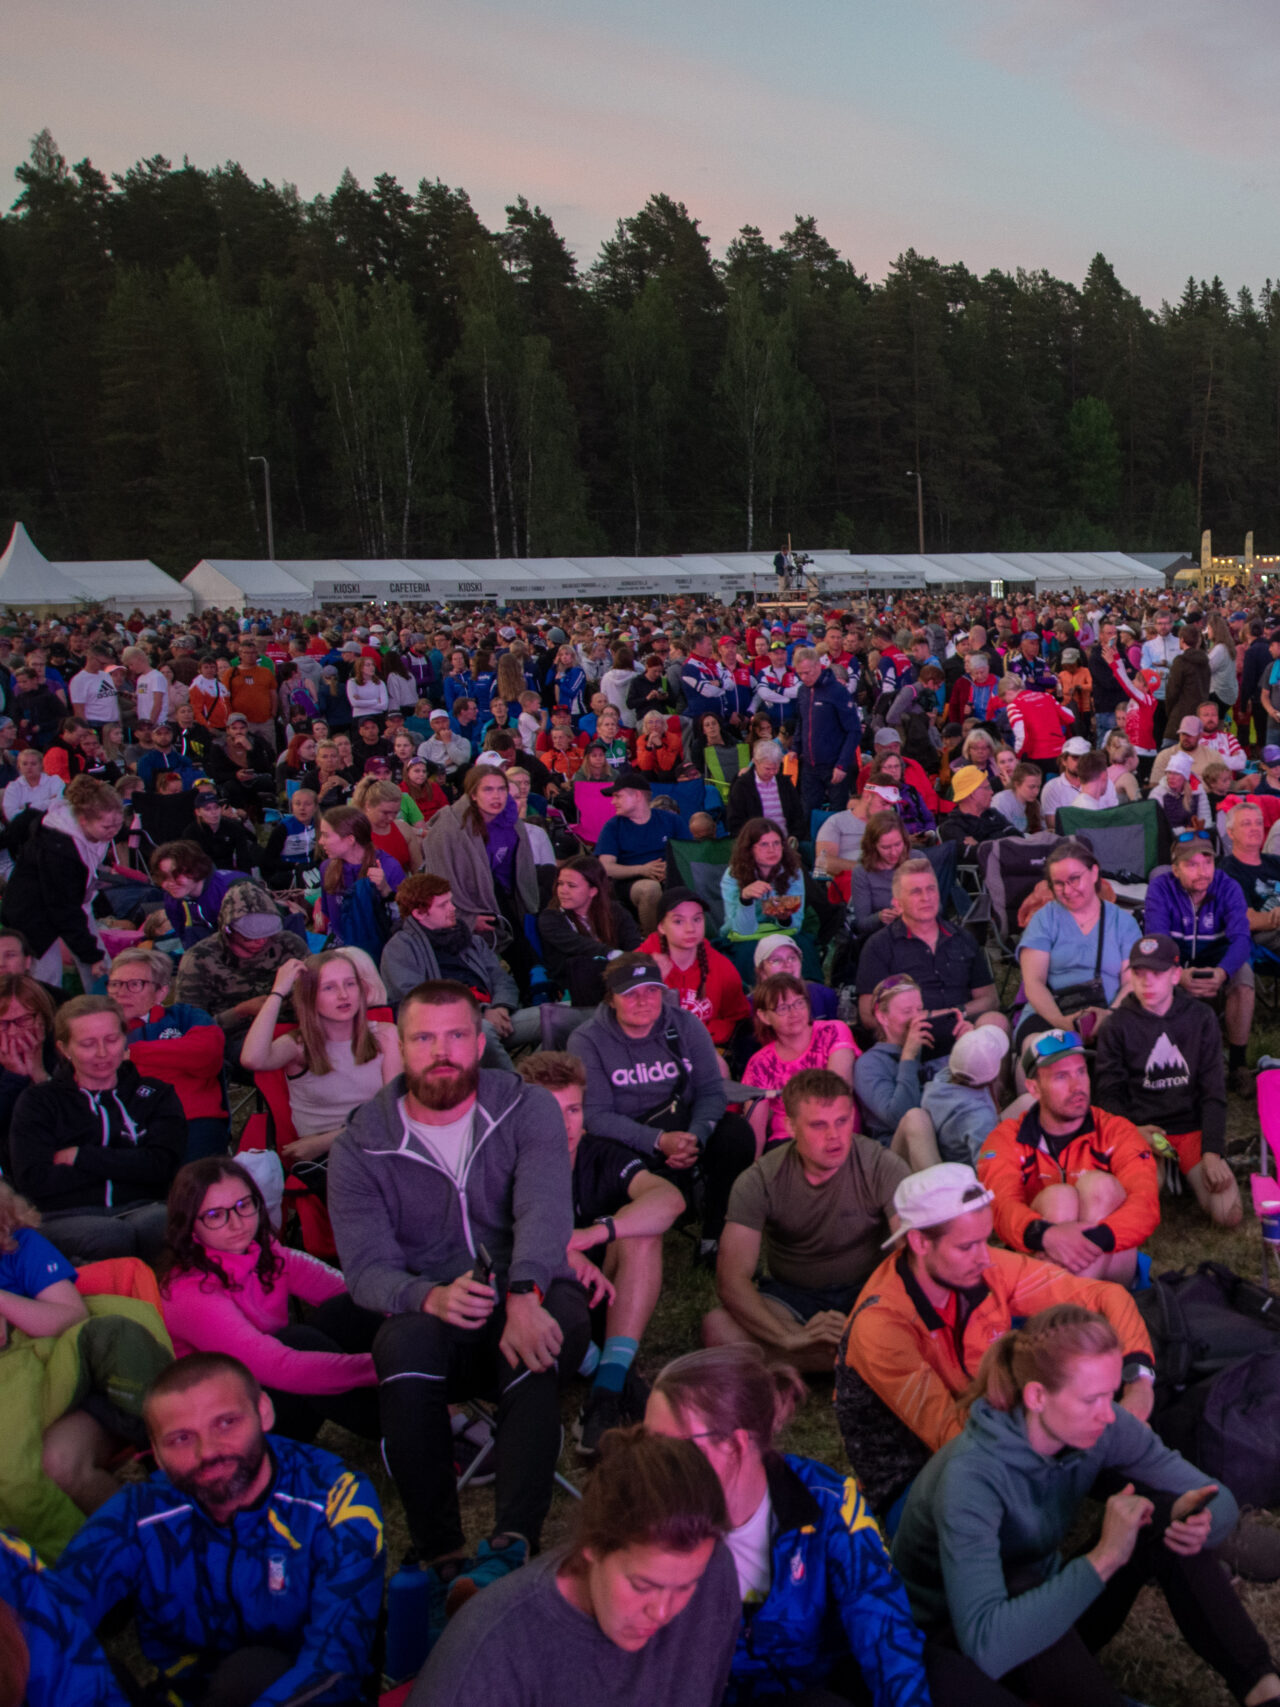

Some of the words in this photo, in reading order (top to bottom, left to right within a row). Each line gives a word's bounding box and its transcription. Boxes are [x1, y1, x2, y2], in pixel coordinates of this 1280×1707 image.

[333, 583, 360, 594] KIOSKI
[389, 582, 431, 593] CAFETERIA
[458, 582, 483, 592] KIOSKI
[1142, 1074, 1190, 1090] BURTON
